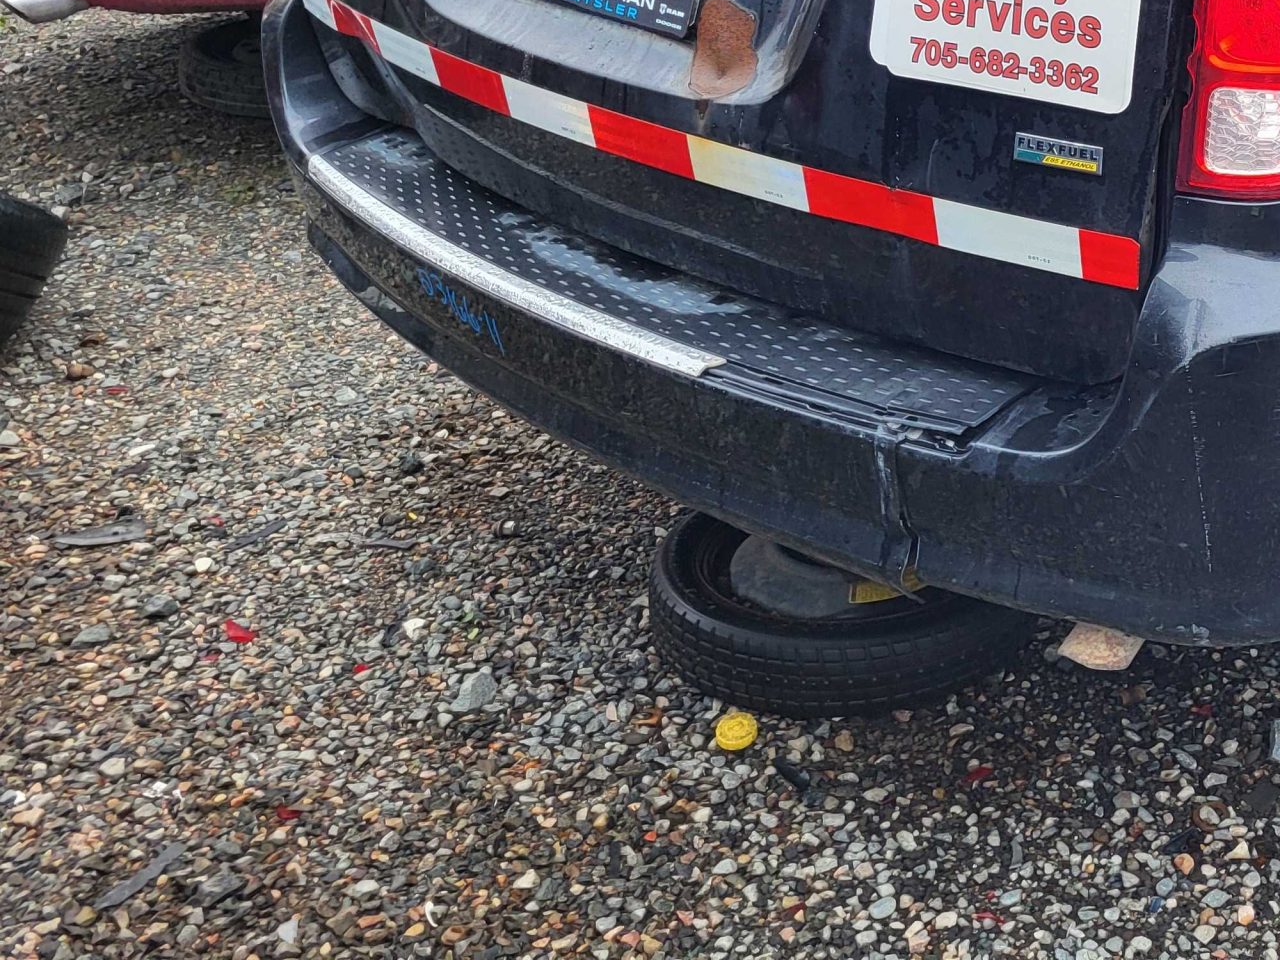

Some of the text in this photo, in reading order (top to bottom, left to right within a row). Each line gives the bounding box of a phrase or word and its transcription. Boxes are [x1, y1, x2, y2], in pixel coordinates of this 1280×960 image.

[909, 36, 1100, 95] 705-682-3362
[1017, 137, 1099, 161] FLEXFUEL
[1060, 158, 1095, 170] ETHANOL
